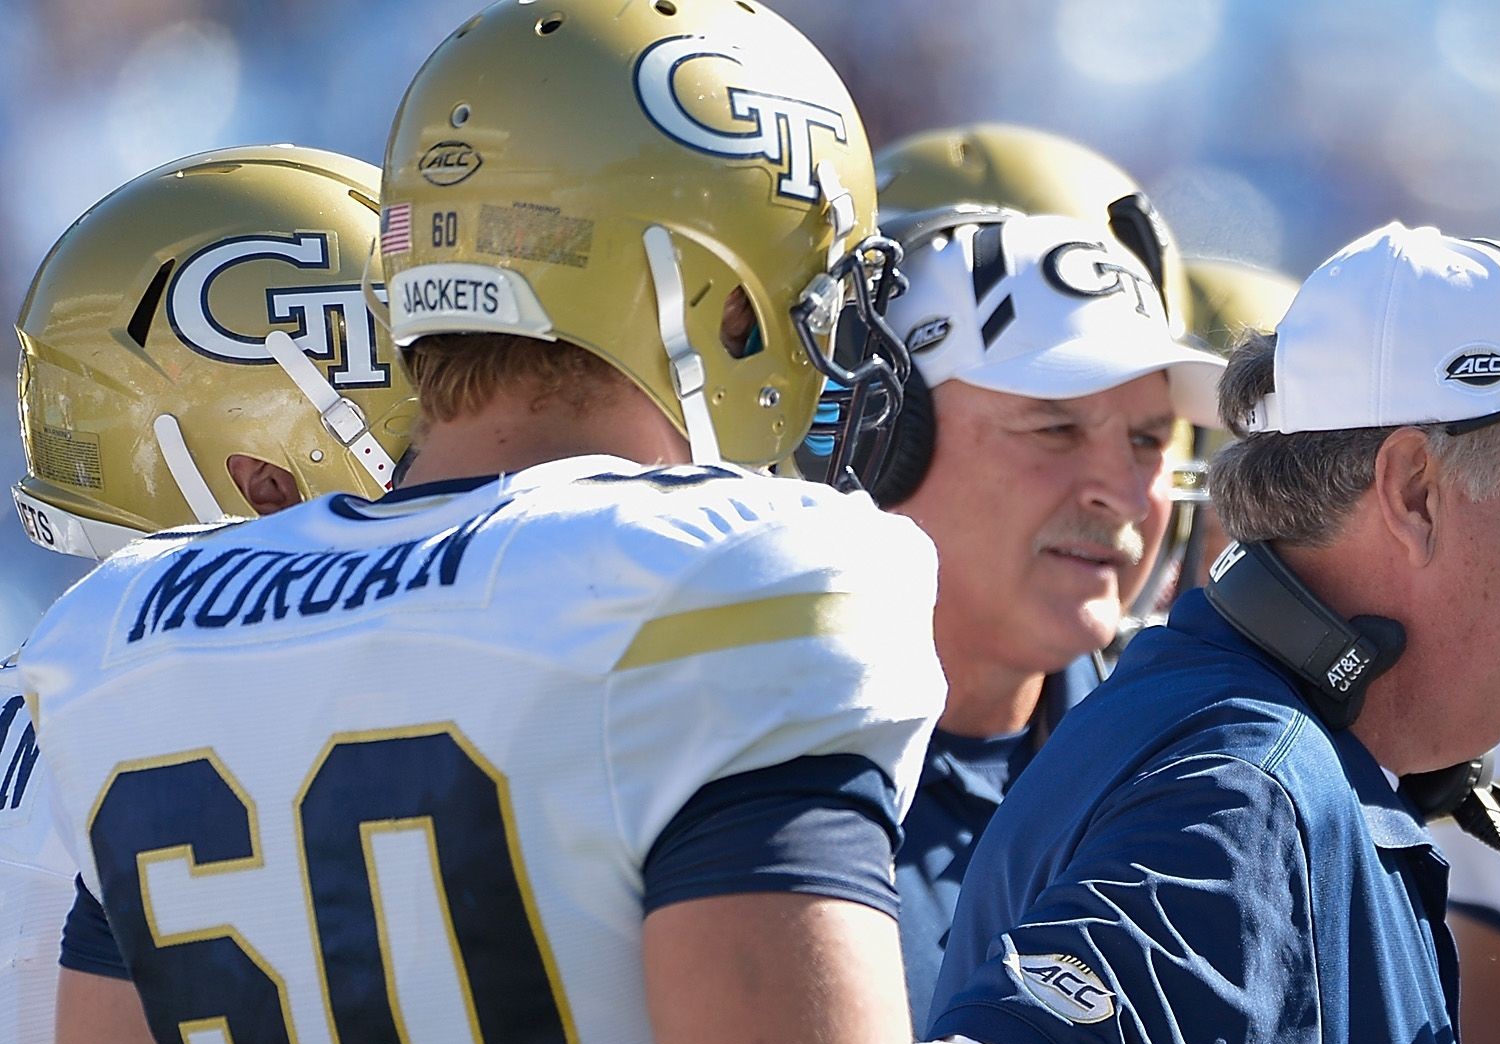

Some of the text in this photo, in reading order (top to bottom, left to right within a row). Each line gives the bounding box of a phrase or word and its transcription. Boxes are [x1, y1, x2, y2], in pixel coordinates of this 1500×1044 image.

[632, 34, 847, 204] GT
[427, 151, 473, 168] ACC
[432, 211, 458, 248] 60
[403, 279, 499, 314] JACKETS
[1041, 240, 1153, 318] GT
[166, 233, 391, 388] GT
[910, 317, 949, 347] ACC
[127, 499, 514, 644] MORGAN
[1325, 648, 1361, 688] AT&T
[1021, 965, 1108, 1010] ACC
